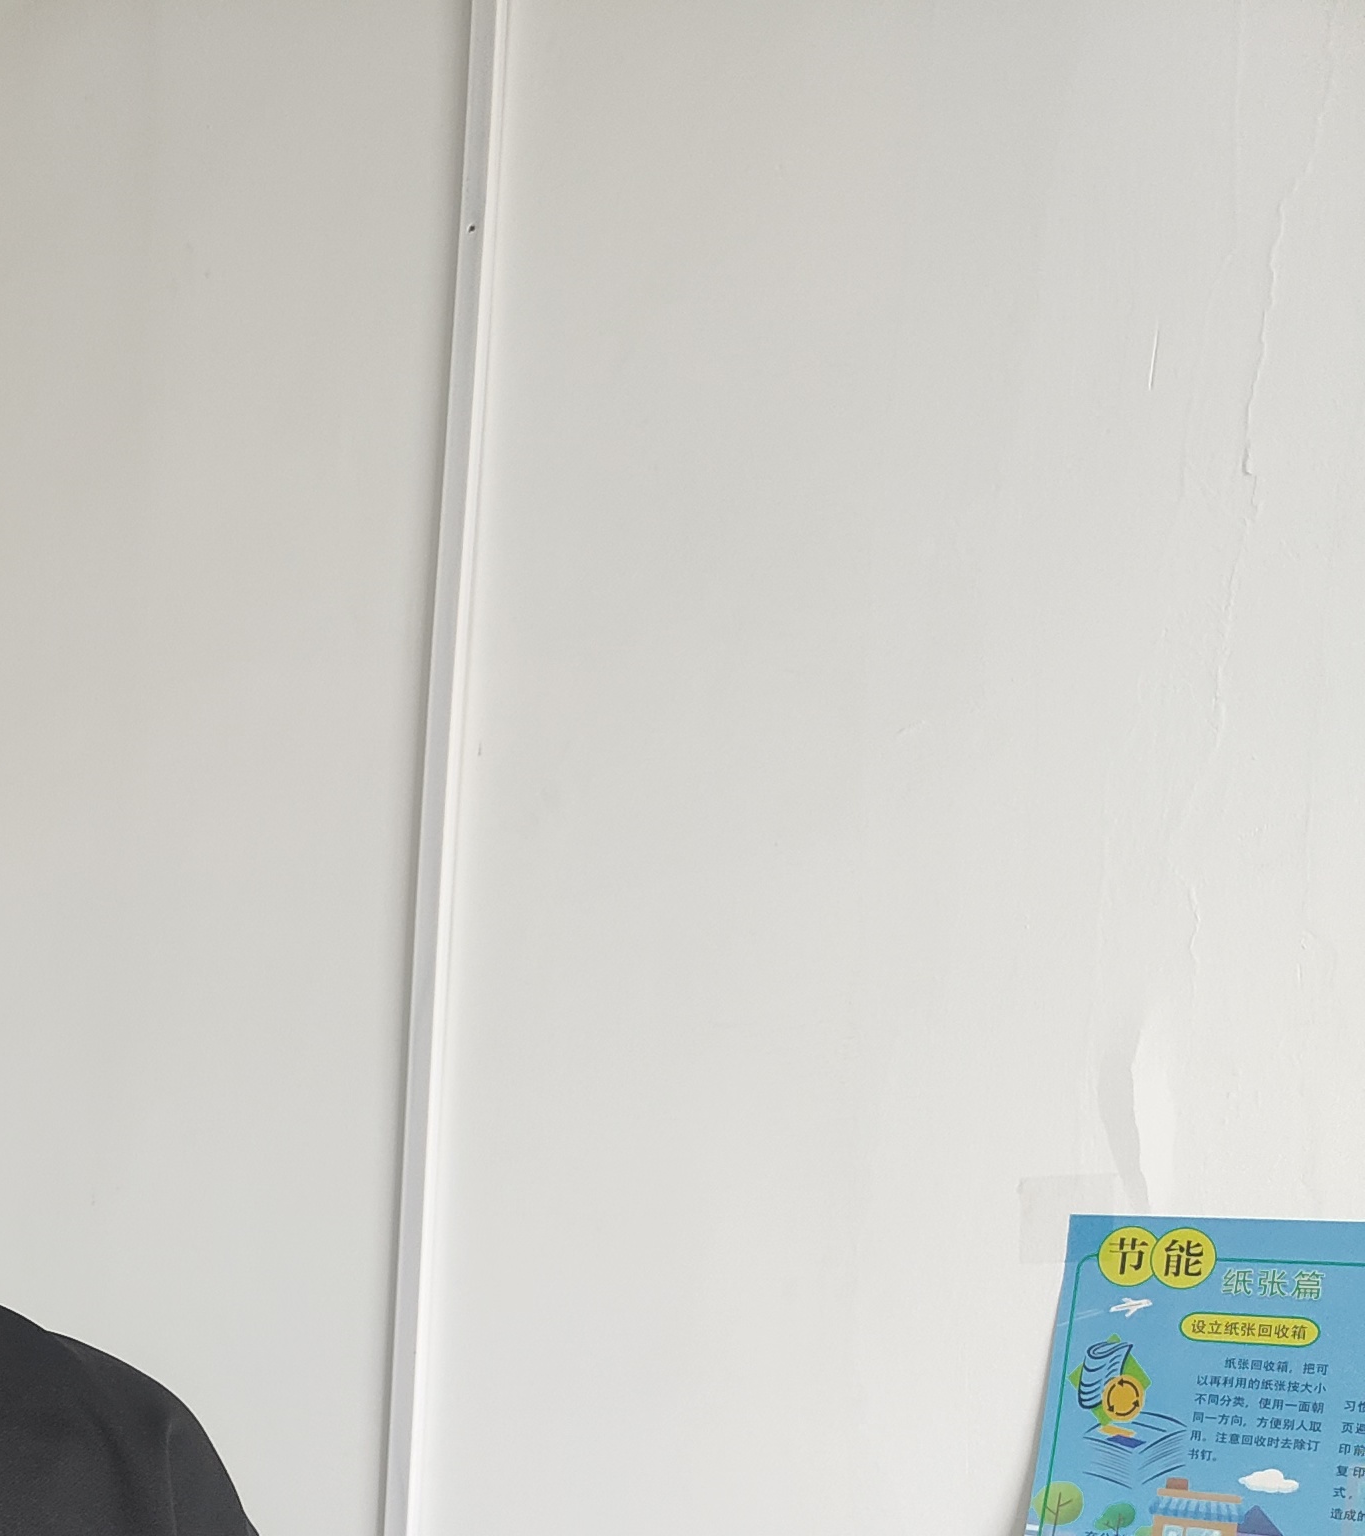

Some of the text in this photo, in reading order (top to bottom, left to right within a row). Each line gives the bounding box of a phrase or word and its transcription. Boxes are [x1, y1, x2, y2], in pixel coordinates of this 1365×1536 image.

[1109, 1237, 1204, 1278] 节能
[1222, 1268, 1325, 1300] 纸张篇
[1191, 1319, 1308, 1341] 设立纸张回收箱
[1197, 1375, 1326, 1394] 以再利用的纸张按大小
